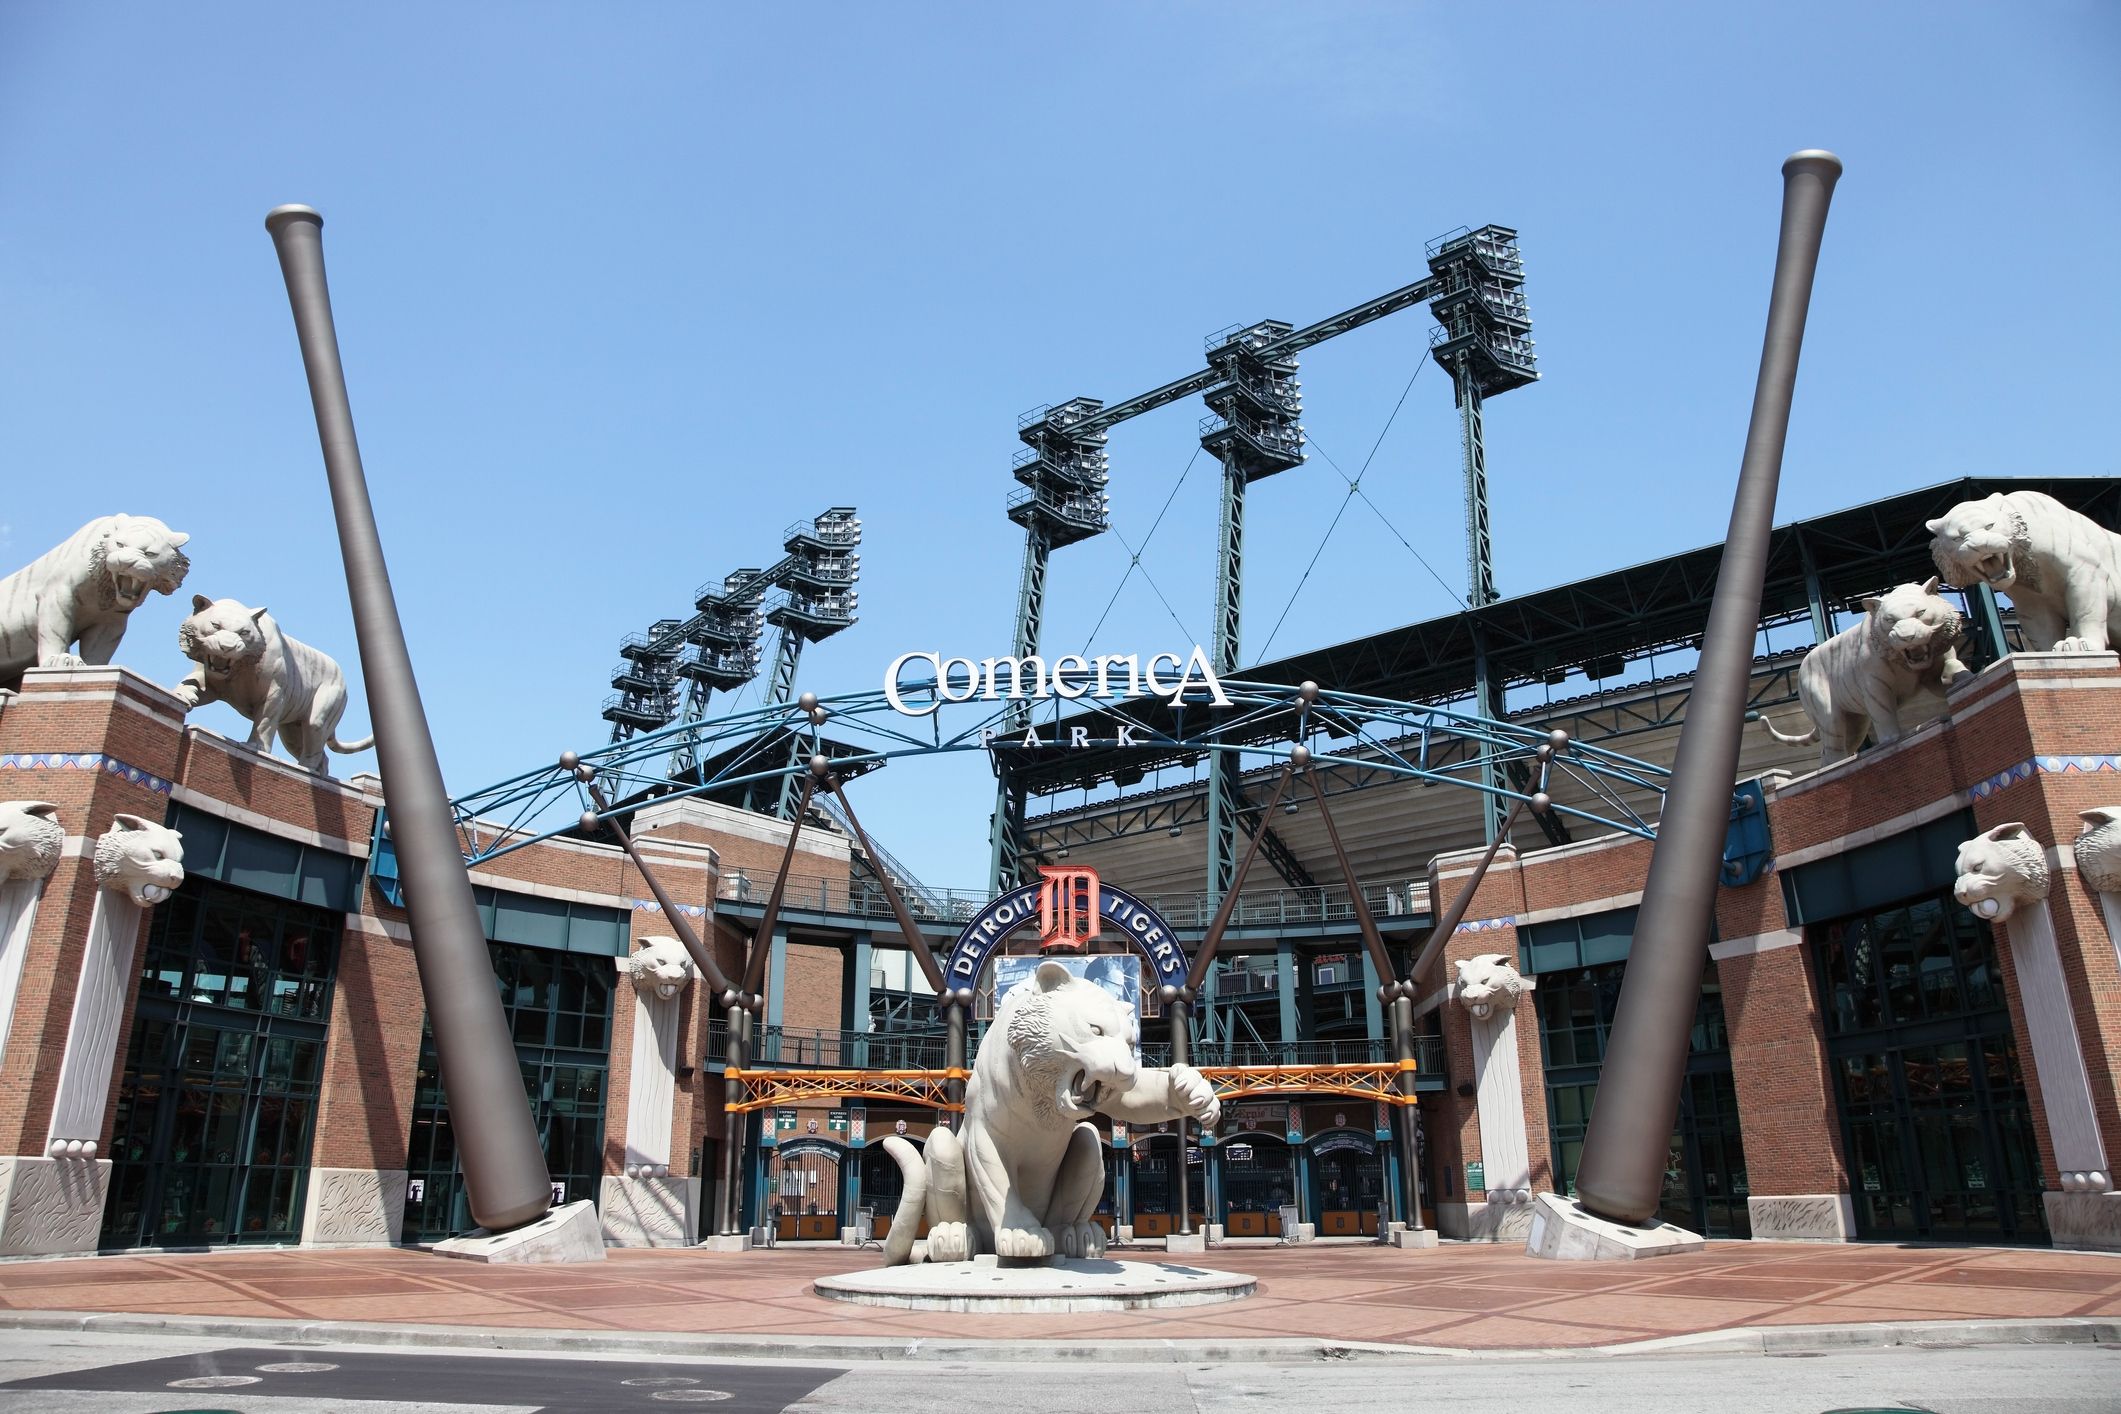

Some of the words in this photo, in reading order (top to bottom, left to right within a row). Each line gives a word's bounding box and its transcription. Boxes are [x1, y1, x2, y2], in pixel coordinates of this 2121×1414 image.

[980, 725, 1138, 749] PARK
[954, 892, 1034, 975] DETROIT
[1108, 895, 1181, 973] TIGERS
